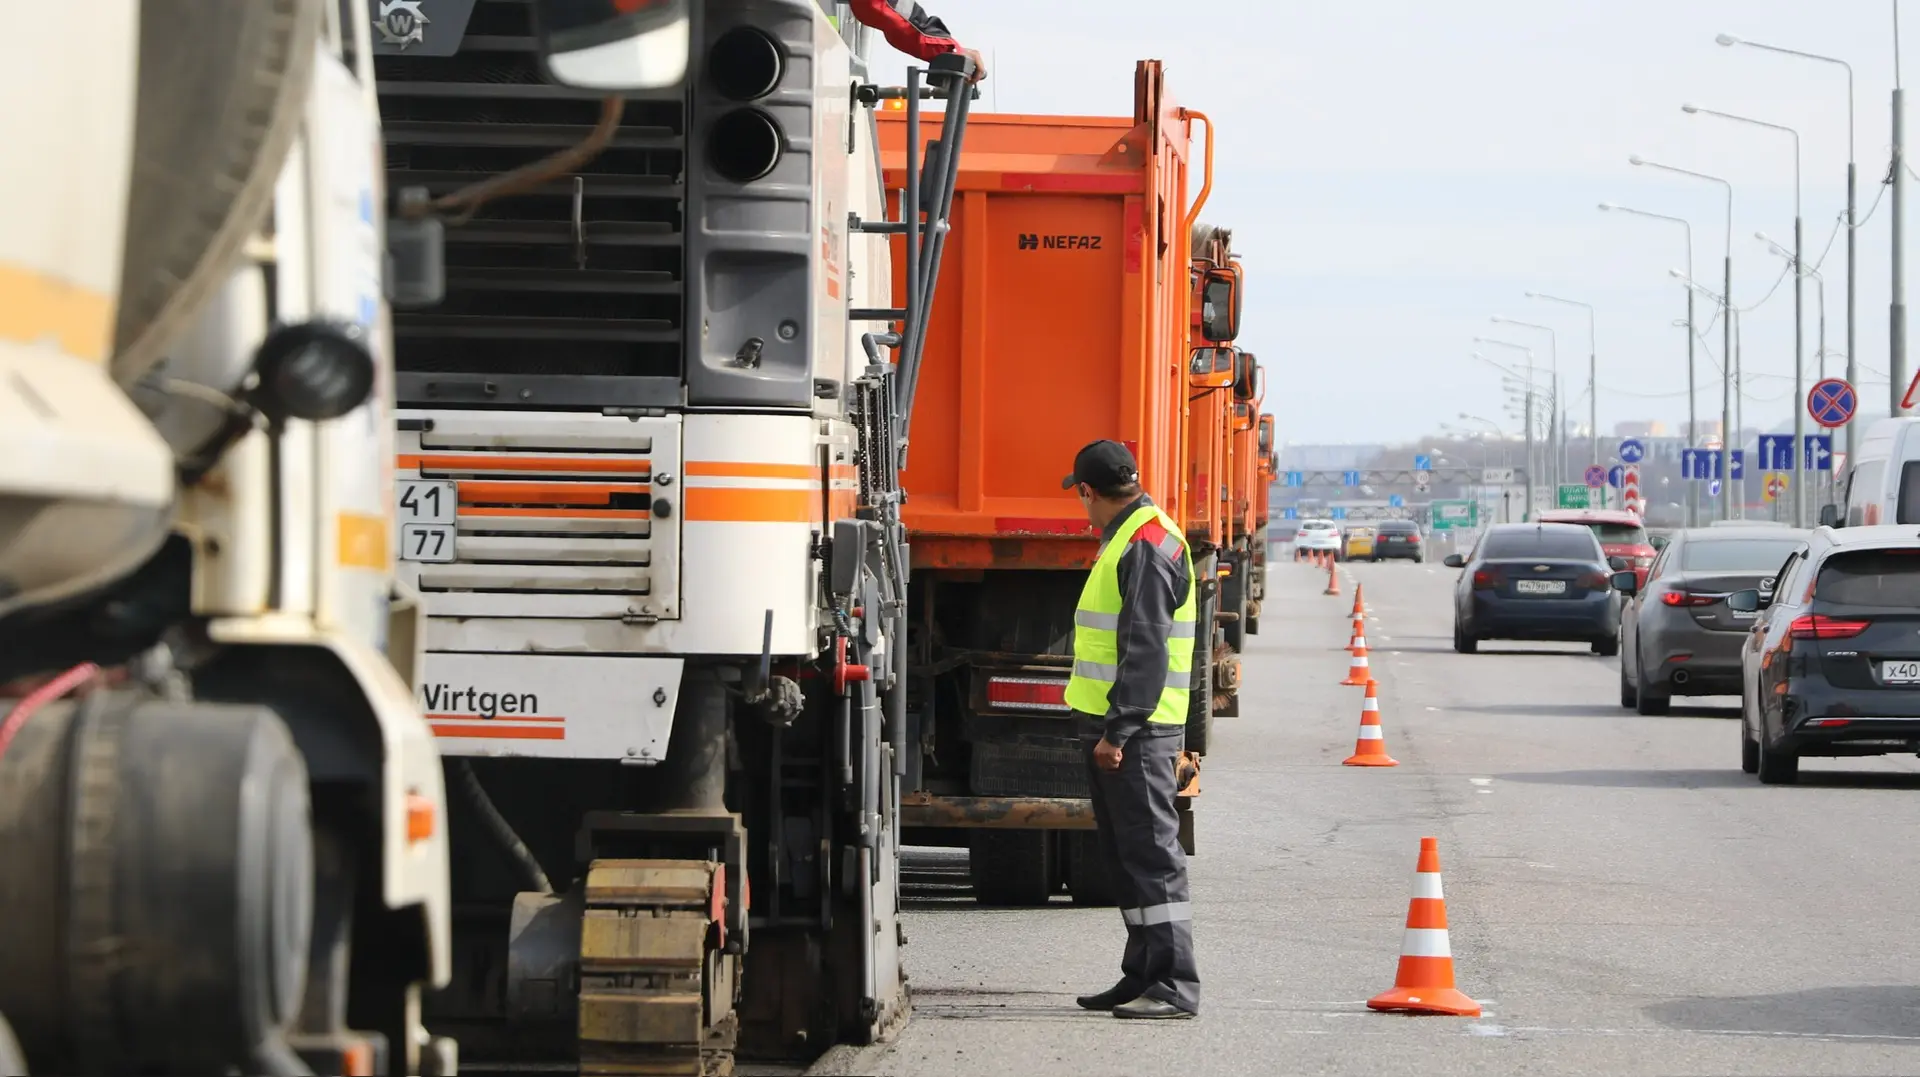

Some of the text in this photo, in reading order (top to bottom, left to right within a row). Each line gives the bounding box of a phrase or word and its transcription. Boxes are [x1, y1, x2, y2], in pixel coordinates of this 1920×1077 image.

[391, 15, 412, 33] W
[1043, 235, 1102, 249] NEFAZ
[400, 485, 440, 517] 41
[412, 529, 446, 555] 77
